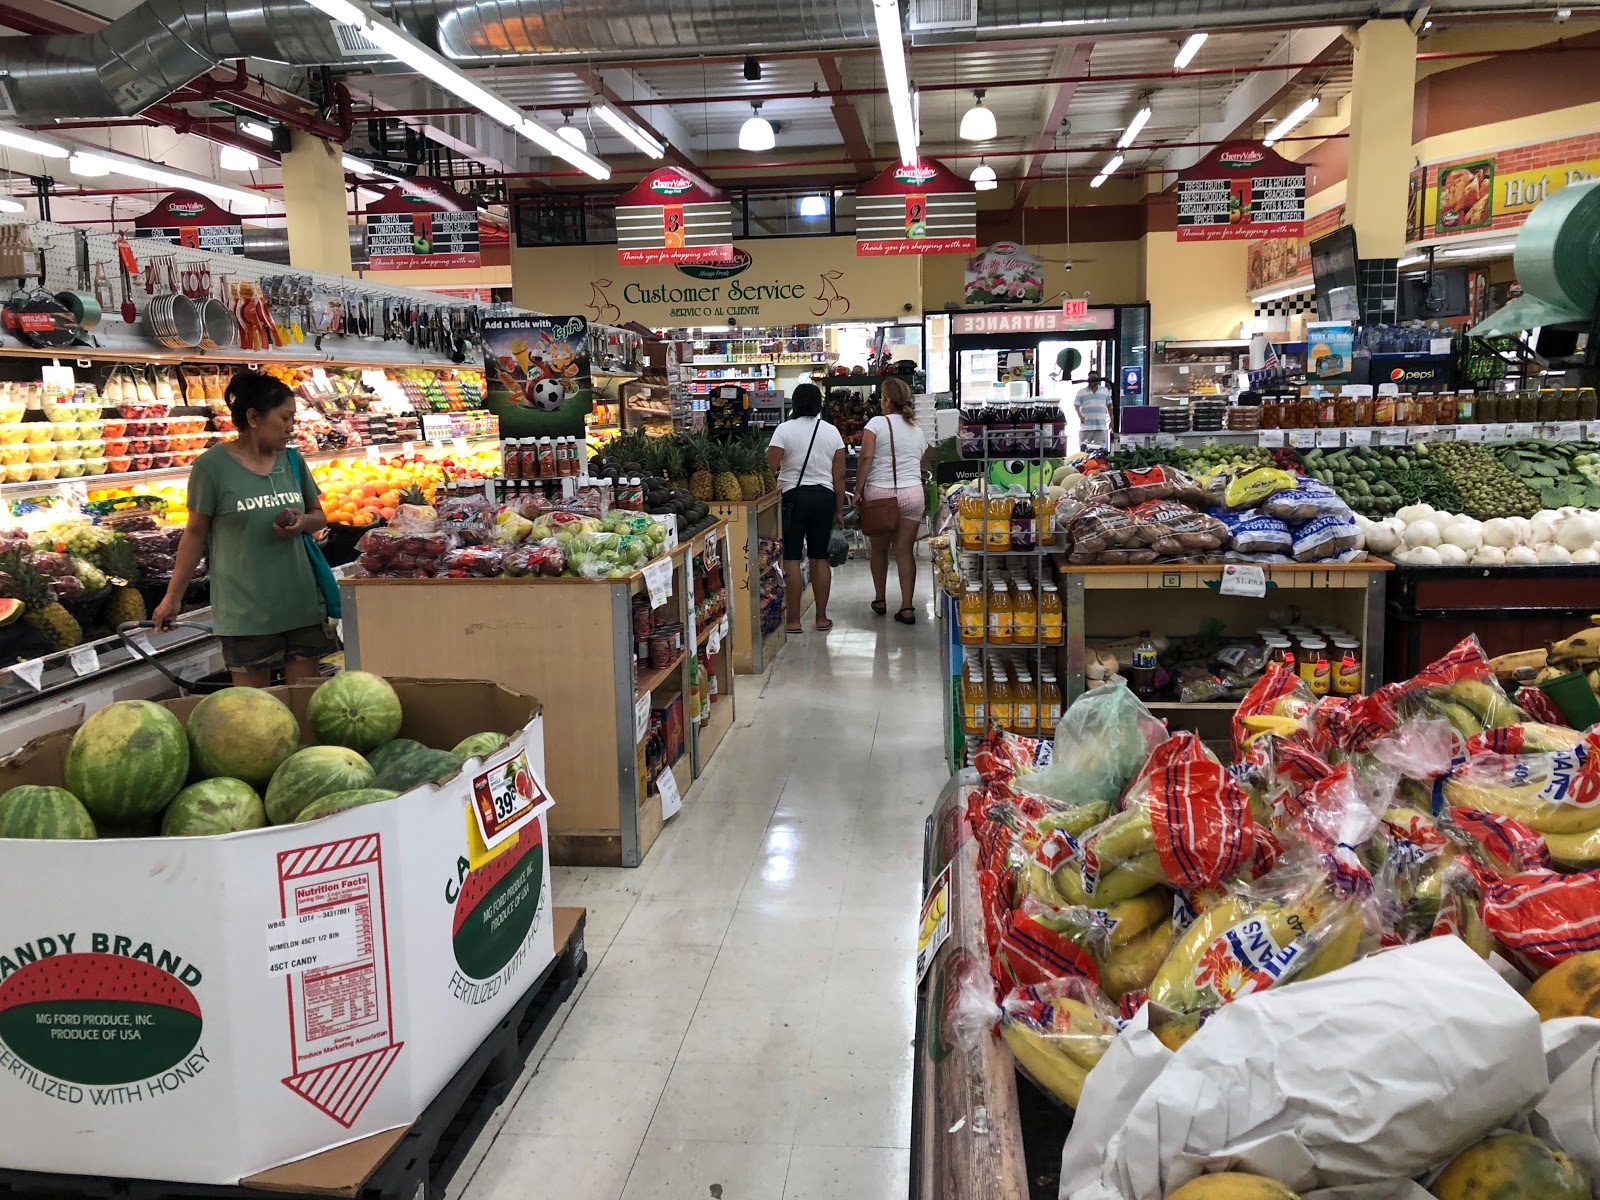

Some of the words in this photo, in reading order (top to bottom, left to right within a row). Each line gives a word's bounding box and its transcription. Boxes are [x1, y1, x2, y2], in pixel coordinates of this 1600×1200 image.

[1184, 182, 1204, 191] FRESH
[1204, 181, 1225, 190] FRUITS
[1254, 179, 1268, 188] DELI
[1286, 177, 1304, 187] FOOD
[1263, 189, 1296, 199] CRACKERS
[1504, 174, 1549, 207] Hot
[1180, 193, 1200, 203] FRESH
[1201, 192, 1228, 202] PRODUCE
[1180, 204, 1207, 214] ORGANIC
[1207, 204, 1228, 213] JUICES
[1261, 201, 1277, 211] POTS
[1282, 200, 1299, 209] PANS
[380, 215, 400, 223] PASTAS
[434, 213, 450, 222] SALAD
[451, 212, 476, 221] DRESSING
[909, 204, 922, 223] 2
[1254, 213, 1281, 222] GRILLING
[1282, 212, 1302, 220] NEEDS
[668, 214, 679, 232] 3
[1193, 215, 1214, 224] SPICES
[375, 225, 395, 234] TOMATO
[396, 225, 411, 233] PASTE
[442, 224, 453, 233] BBQ
[454, 223, 471, 232] SAUCE
[1182, 228, 1205, 237] Thank
[1207, 230, 1222, 240] you
[1221, 228, 1233, 238] for
[1235, 227, 1268, 237] shopping
[1270, 226, 1287, 234] with
[201, 237, 227, 246] ARGENTINA
[371, 236, 386, 245] MASH
[386, 235, 411, 245] POTATOES
[450, 234, 463, 243] OILS
[370, 247, 382, 255] CAN
[382, 246, 413, 254] VEGETABLES
[450, 245, 464, 253] SOUP
[861, 243, 883, 251] Thank
[884, 245, 899, 255] you
[899, 244, 910, 253] for
[911, 242, 943, 252] shopping
[945, 241, 960, 249] with
[623, 252, 644, 260] Thank
[645, 254, 659, 263] you
[658, 252, 669, 262] for
[671, 250, 701, 260] shopping
[703, 249, 718, 257] with
[375, 258, 394, 266] Thank
[396, 259, 409, 269] you
[409, 258, 419, 269] for
[420, 258, 450, 268] shopping
[451, 257, 466, 265] with
[623, 282, 720, 304] Customer
[728, 280, 805, 301] Service
[714, 307, 724, 316] AL
[727, 306, 760, 316] CLIENTE
[1066, 301, 1085, 316] EXIT
[485, 320, 502, 329] Add
[511, 320, 531, 329] Kick
[531, 319, 551, 328] with
[1406, 369, 1435, 384] pepsi
[297, 884, 339, 899] Nutrition
[341, 877, 368, 889] Facts
[492, 892, 506, 914] FORD
[299, 915, 315, 923] LOT#
[490, 906, 514, 933] PRODUCE
[269, 940, 299, 952] W/MELON
[301, 936, 316, 946] 45CT
[92, 932, 203, 988] BRAND
[269, 961, 289, 972] 45CT
[291, 955, 317, 968] CANDY
[448, 970, 501, 1005] FERTILIZED
[503, 949, 527, 986] WITH
[36, 1014, 53, 1024] MG
[54, 1014, 81, 1025] FORD
[83, 1015, 133, 1027] PRODUCE,
[135, 1015, 156, 1026] INC.
[51, 1029, 100, 1040] PRODUCE
[102, 1029, 117, 1040] OF
[120, 1029, 142, 1040] USA
[298, 1050, 323, 1062] Produce
[323, 1040, 355, 1054] Marketing
[355, 1030, 388, 1044] Association
[89, 1084, 143, 1106] WITH
[147, 1046, 211, 1099] HONEY
